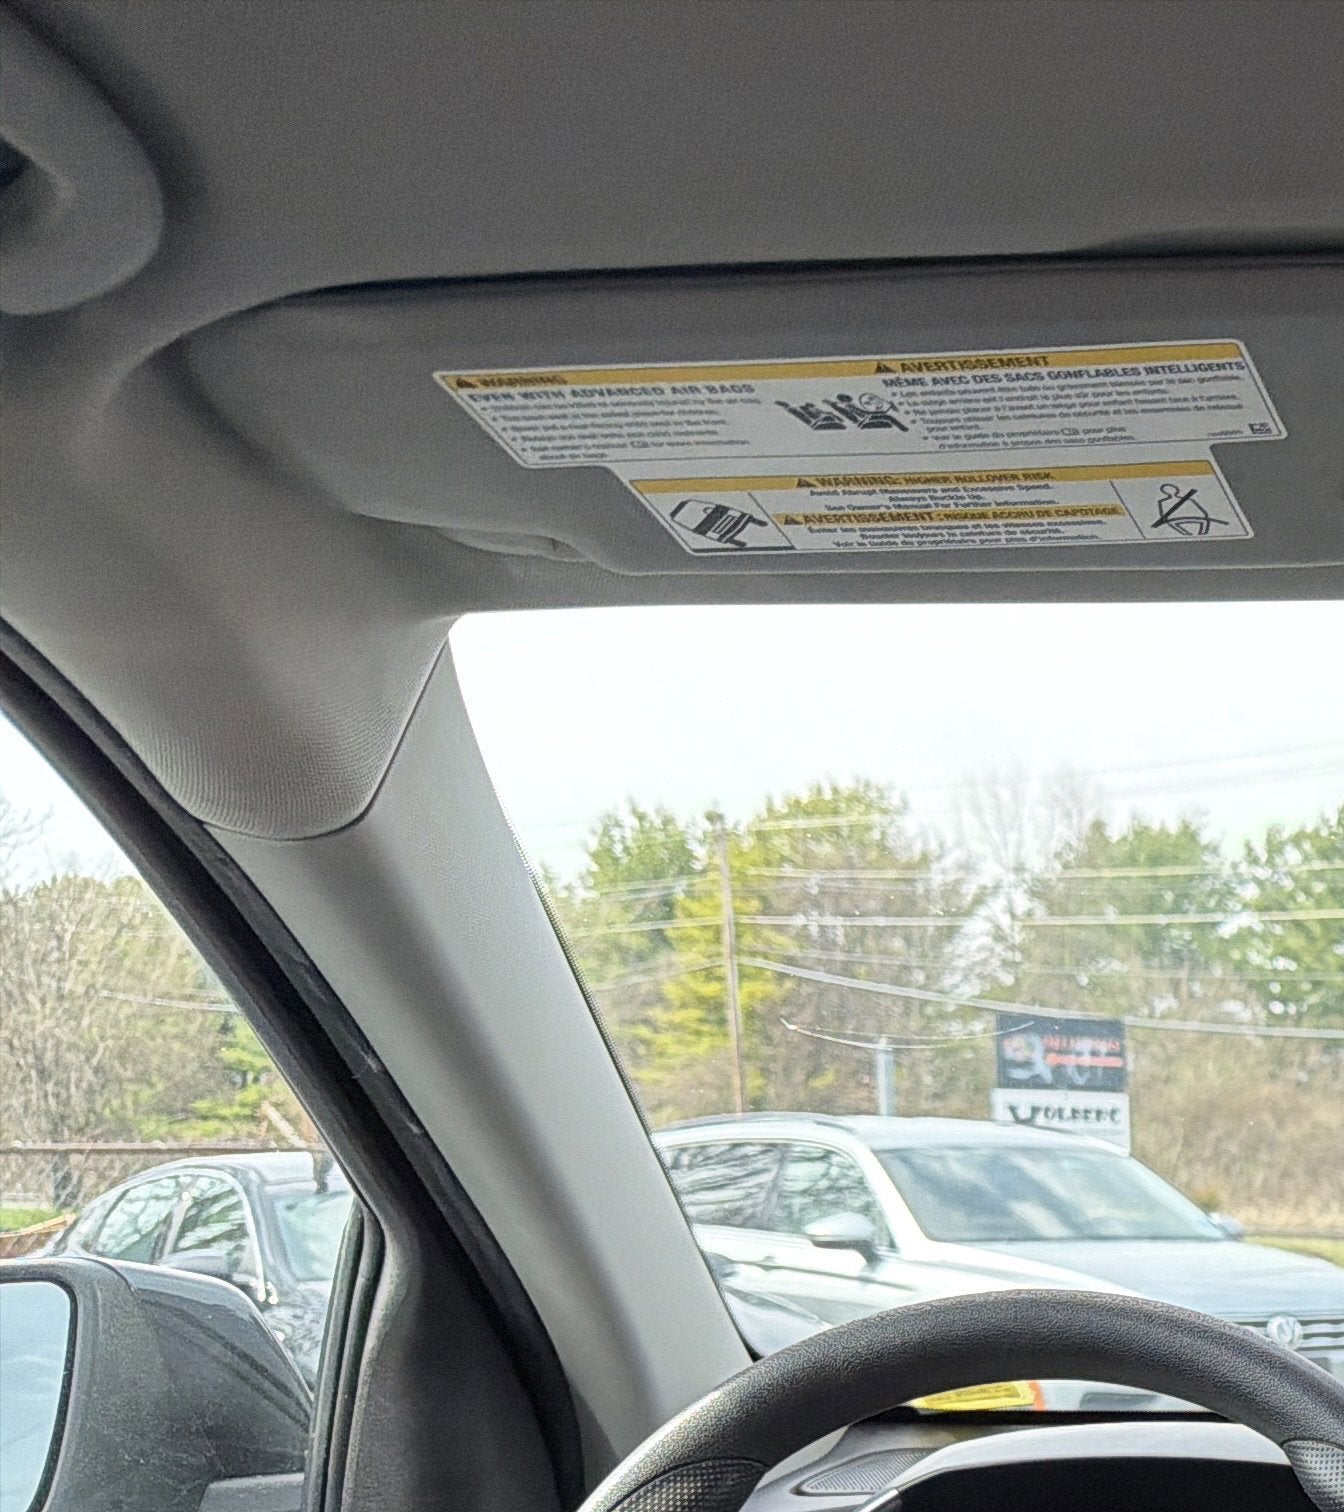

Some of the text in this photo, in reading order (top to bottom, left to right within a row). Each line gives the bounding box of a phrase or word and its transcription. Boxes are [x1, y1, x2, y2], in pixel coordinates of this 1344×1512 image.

[900, 356, 1049, 373] AVERTISSEMENT
[931, 374, 970, 386] AVEC
[972, 373, 1003, 384] DES
[1004, 371, 1044, 382] SACS
[1047, 367, 1141, 380] GONFLABLES
[1143, 362, 1245, 376] INTELLIGENTS
[518, 389, 565, 400] WITH
[570, 386, 664, 398] ADVANCED
[671, 384, 703, 395] AIR
[705, 383, 756, 394] BAGS
